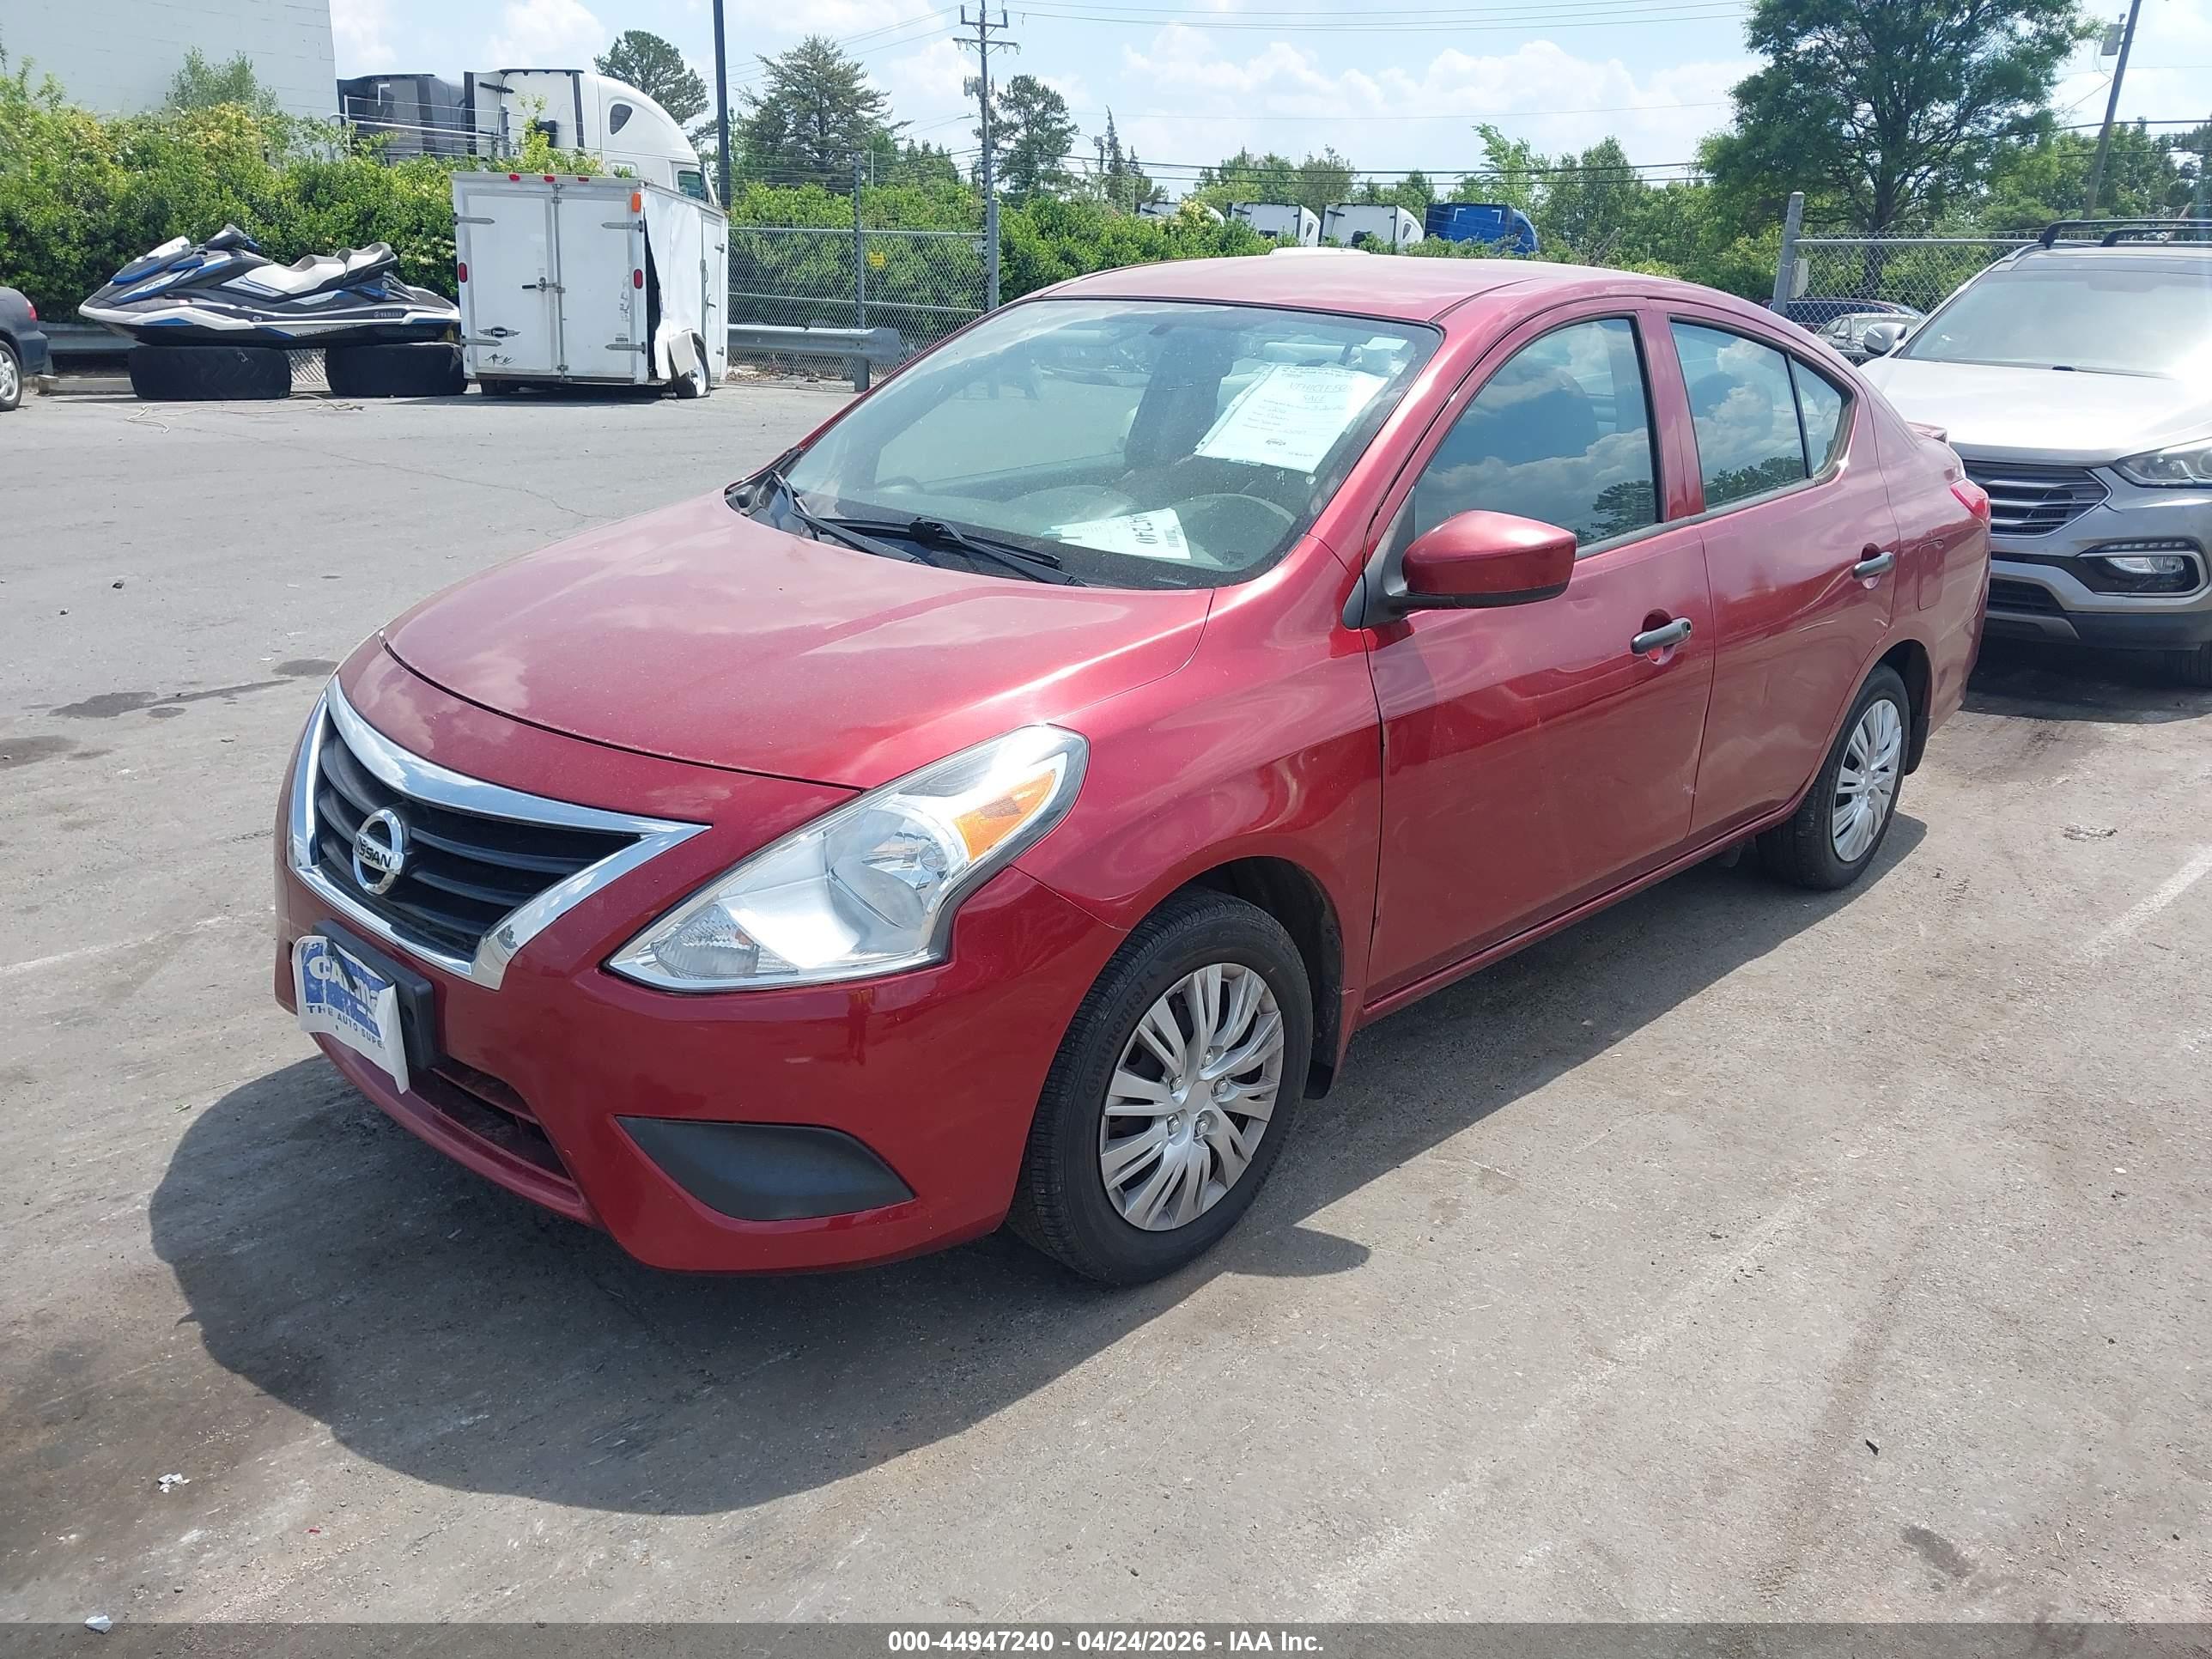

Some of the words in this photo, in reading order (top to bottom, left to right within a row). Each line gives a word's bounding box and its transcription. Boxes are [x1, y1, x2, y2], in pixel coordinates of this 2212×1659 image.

[356, 836, 392, 869] NISSAN
[307, 1005, 333, 1017] THE
[337, 1013, 358, 1031] AUTO
